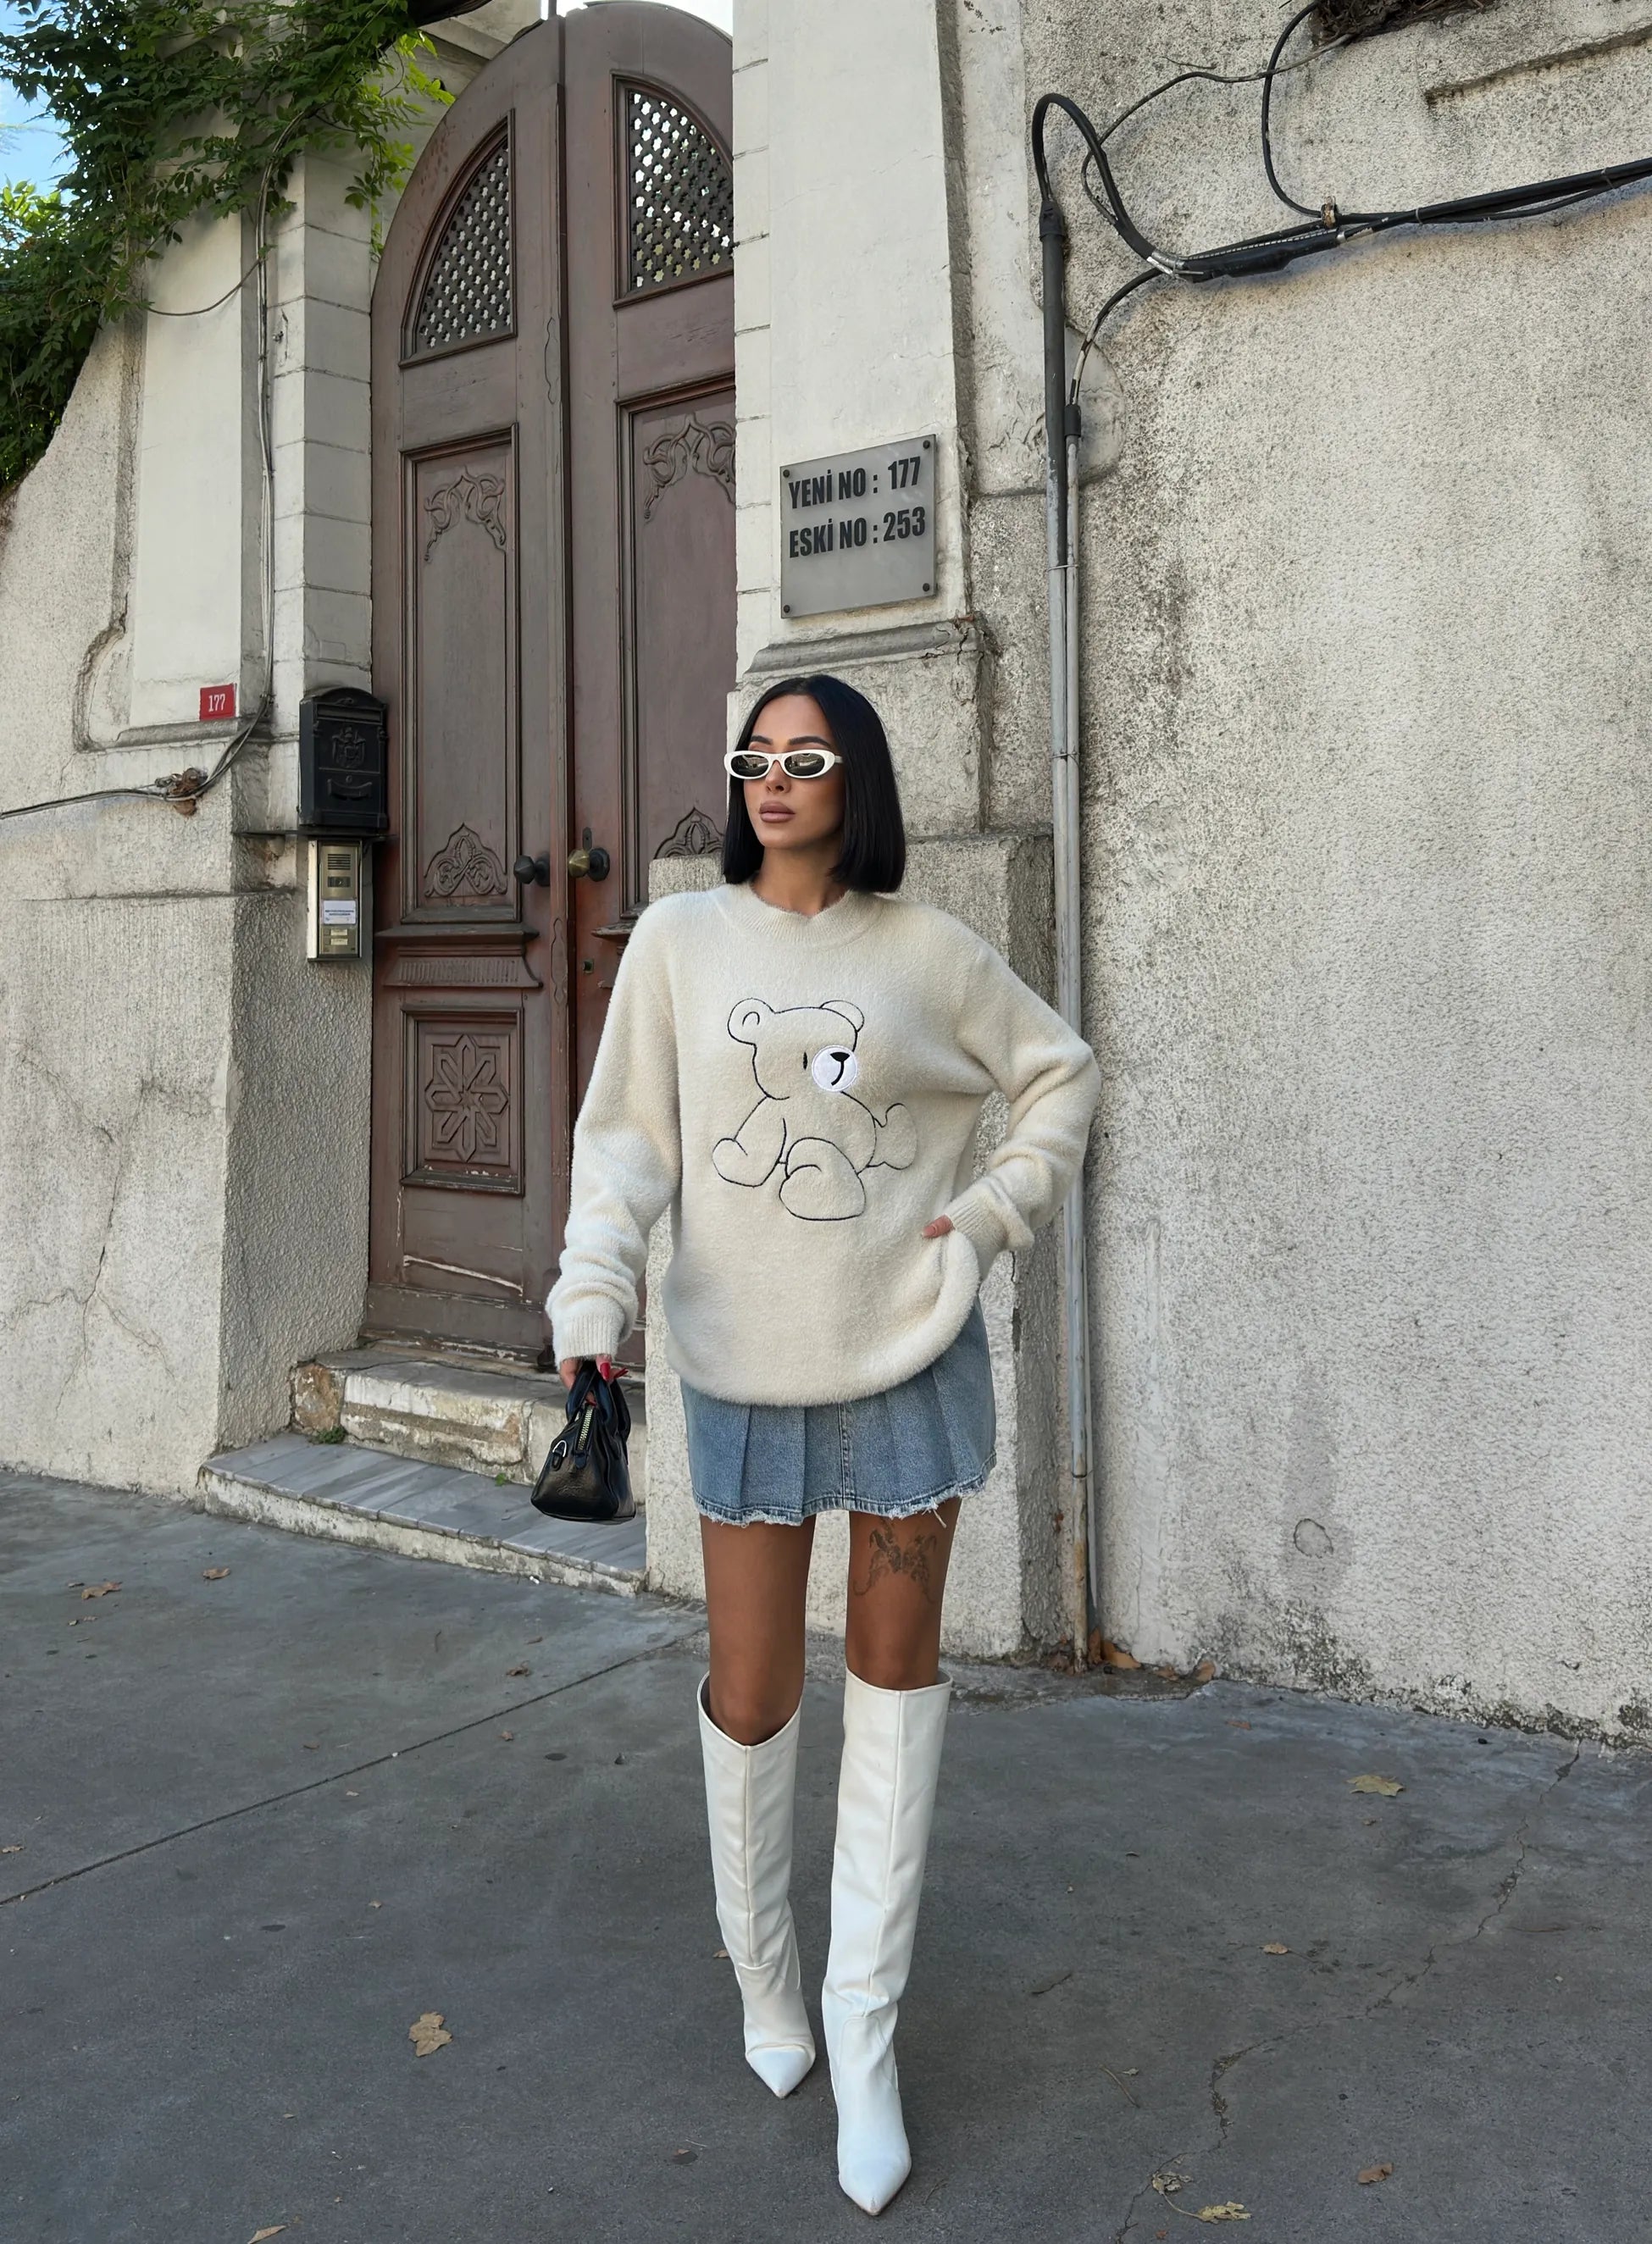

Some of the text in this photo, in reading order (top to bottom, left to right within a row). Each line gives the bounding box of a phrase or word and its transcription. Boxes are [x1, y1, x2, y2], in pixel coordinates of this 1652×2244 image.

[789, 469, 833, 509] YENİ
[839, 468, 867, 500] NO
[888, 456, 921, 490] 177
[790, 518, 834, 558] ESKİ
[840, 518, 868, 550] NO
[883, 507, 926, 542] 253
[208, 693, 226, 712] 177
